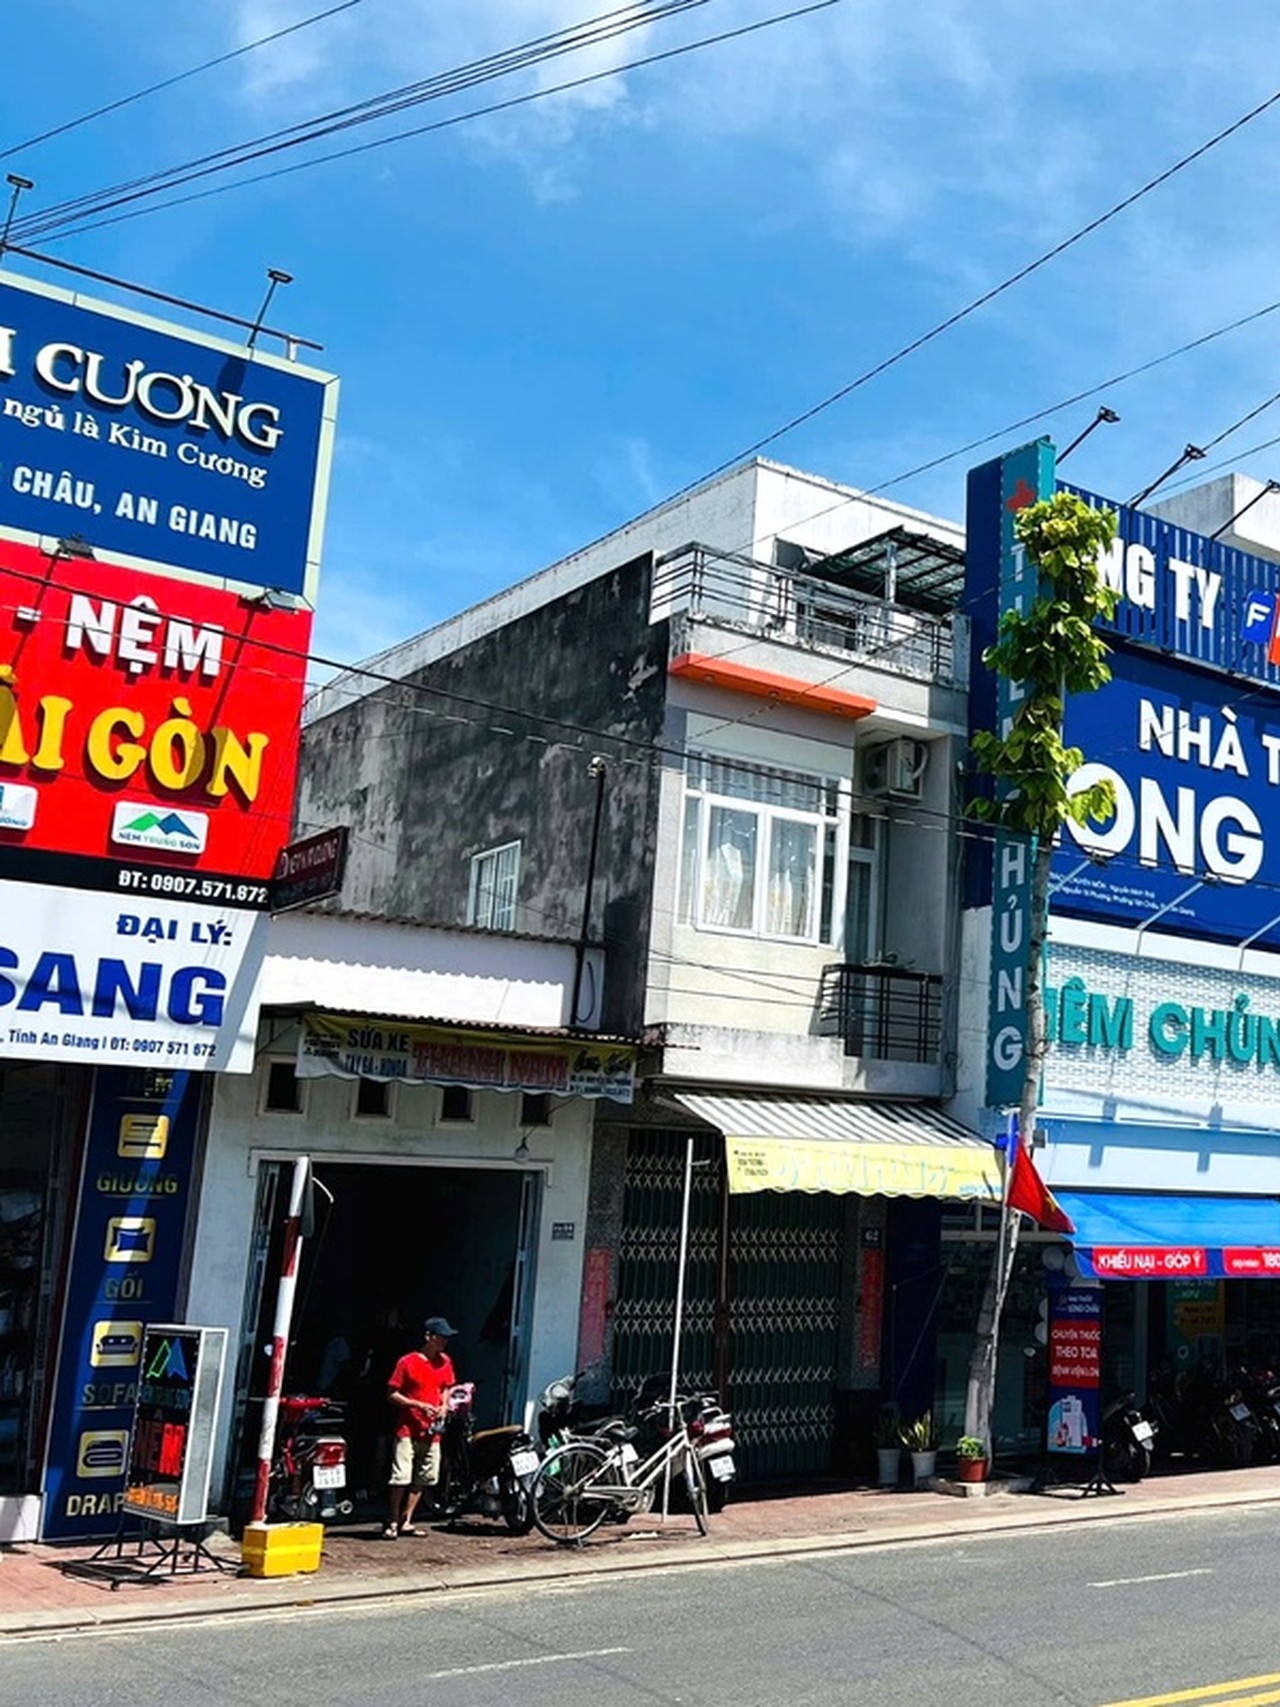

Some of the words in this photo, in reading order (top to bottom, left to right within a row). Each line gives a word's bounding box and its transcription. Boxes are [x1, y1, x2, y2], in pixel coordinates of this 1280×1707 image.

[35, 342, 285, 449] CƯƠNG
[3, 397, 66, 432] ngủ
[73, 411, 100, 440] là
[108, 422, 168, 457] Kim
[176, 442, 268, 489] Cương
[12, 465, 102, 515] CHÂU,
[114, 492, 158, 526] AN
[168, 505, 257, 549] GIANG
[1096, 537, 1156, 611] NG
[1168, 557, 1222, 631] TY
[65, 594, 225, 676] NỆM
[87, 696, 270, 802] GÒN
[1140, 698, 1250, 778] NHÀ
[1052, 763, 1265, 887] ONG
[117, 869, 149, 889] ĐT:
[150, 873, 269, 903] 0907.571.672
[116, 913, 179, 943] ĐẠI
[189, 919, 233, 947] LÝ:
[993, 788, 1027, 1072] HỦNG
[40, 1031, 59, 1046] An
[61, 1032, 100, 1051] Giang
[132, 1038, 162, 1054] 0907
[165, 1040, 189, 1055] 571
[192, 1041, 217, 1058] 672
[347, 1025, 383, 1051] SỬA
[386, 1032, 410, 1053] XE
[1044, 976, 1134, 1051] IÊM
[1164, 1249, 1191, 1271] GÓP
[82, 1382, 138, 1405] SOFA
